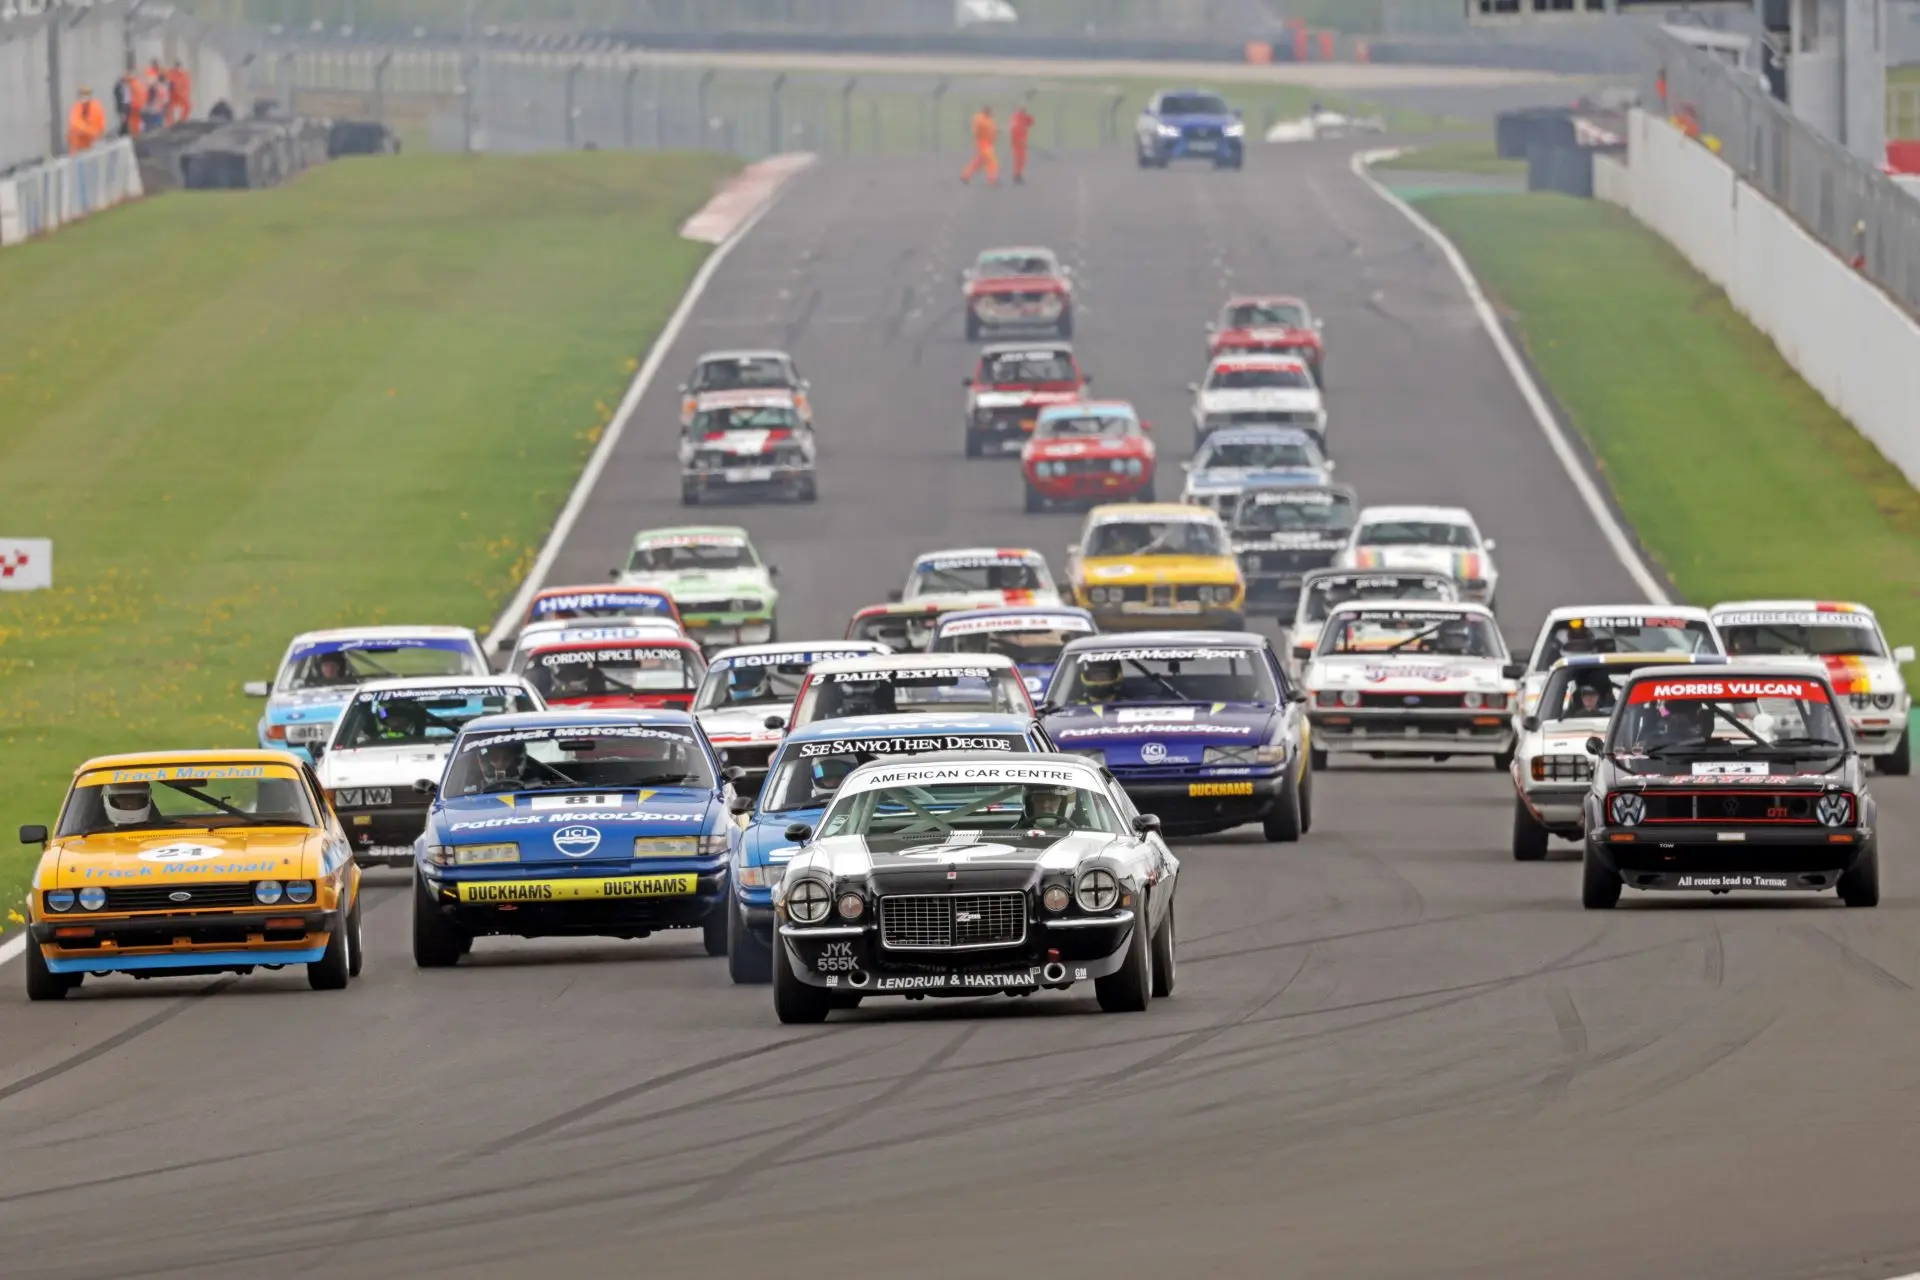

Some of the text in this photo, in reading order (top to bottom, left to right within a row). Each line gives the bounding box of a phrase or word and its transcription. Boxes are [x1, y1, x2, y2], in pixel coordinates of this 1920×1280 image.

[560, 628, 640, 642] FORD
[542, 649, 681, 666] GORDON SPICE RACING
[733, 652, 804, 668] EQUIPE
[833, 671, 892, 683] DAILY
[896, 668, 990, 680] EXPRESS
[1654, 683, 1802, 697] MORRIS VULCAN
[463, 730, 550, 753] Patrick
[799, 743, 830, 758] SEE
[944, 736, 1012, 751] DECIDE
[1145, 745, 1162, 755] ICI
[112, 766, 265, 783] Track Marshall
[869, 769, 1073, 784] AMERICAN CAR CENTRE
[1188, 782, 1254, 797] DUCKHAMS
[450, 814, 541, 832] Patrick
[565, 829, 588, 838] ICI
[156, 847, 203, 859] 24
[85, 861, 276, 879] Track Marshall
[1678, 876, 1787, 887] All routes lead to Tarmac
[468, 878, 688, 901] DUCKHAMS DUCKHAMS
[821, 942, 853, 957] JYK
[817, 956, 859, 971] 555K
[826, 975, 838, 986] GM
[877, 973, 1035, 989] LENDRUM & HARTMAN
[1074, 968, 1087, 980] GM
